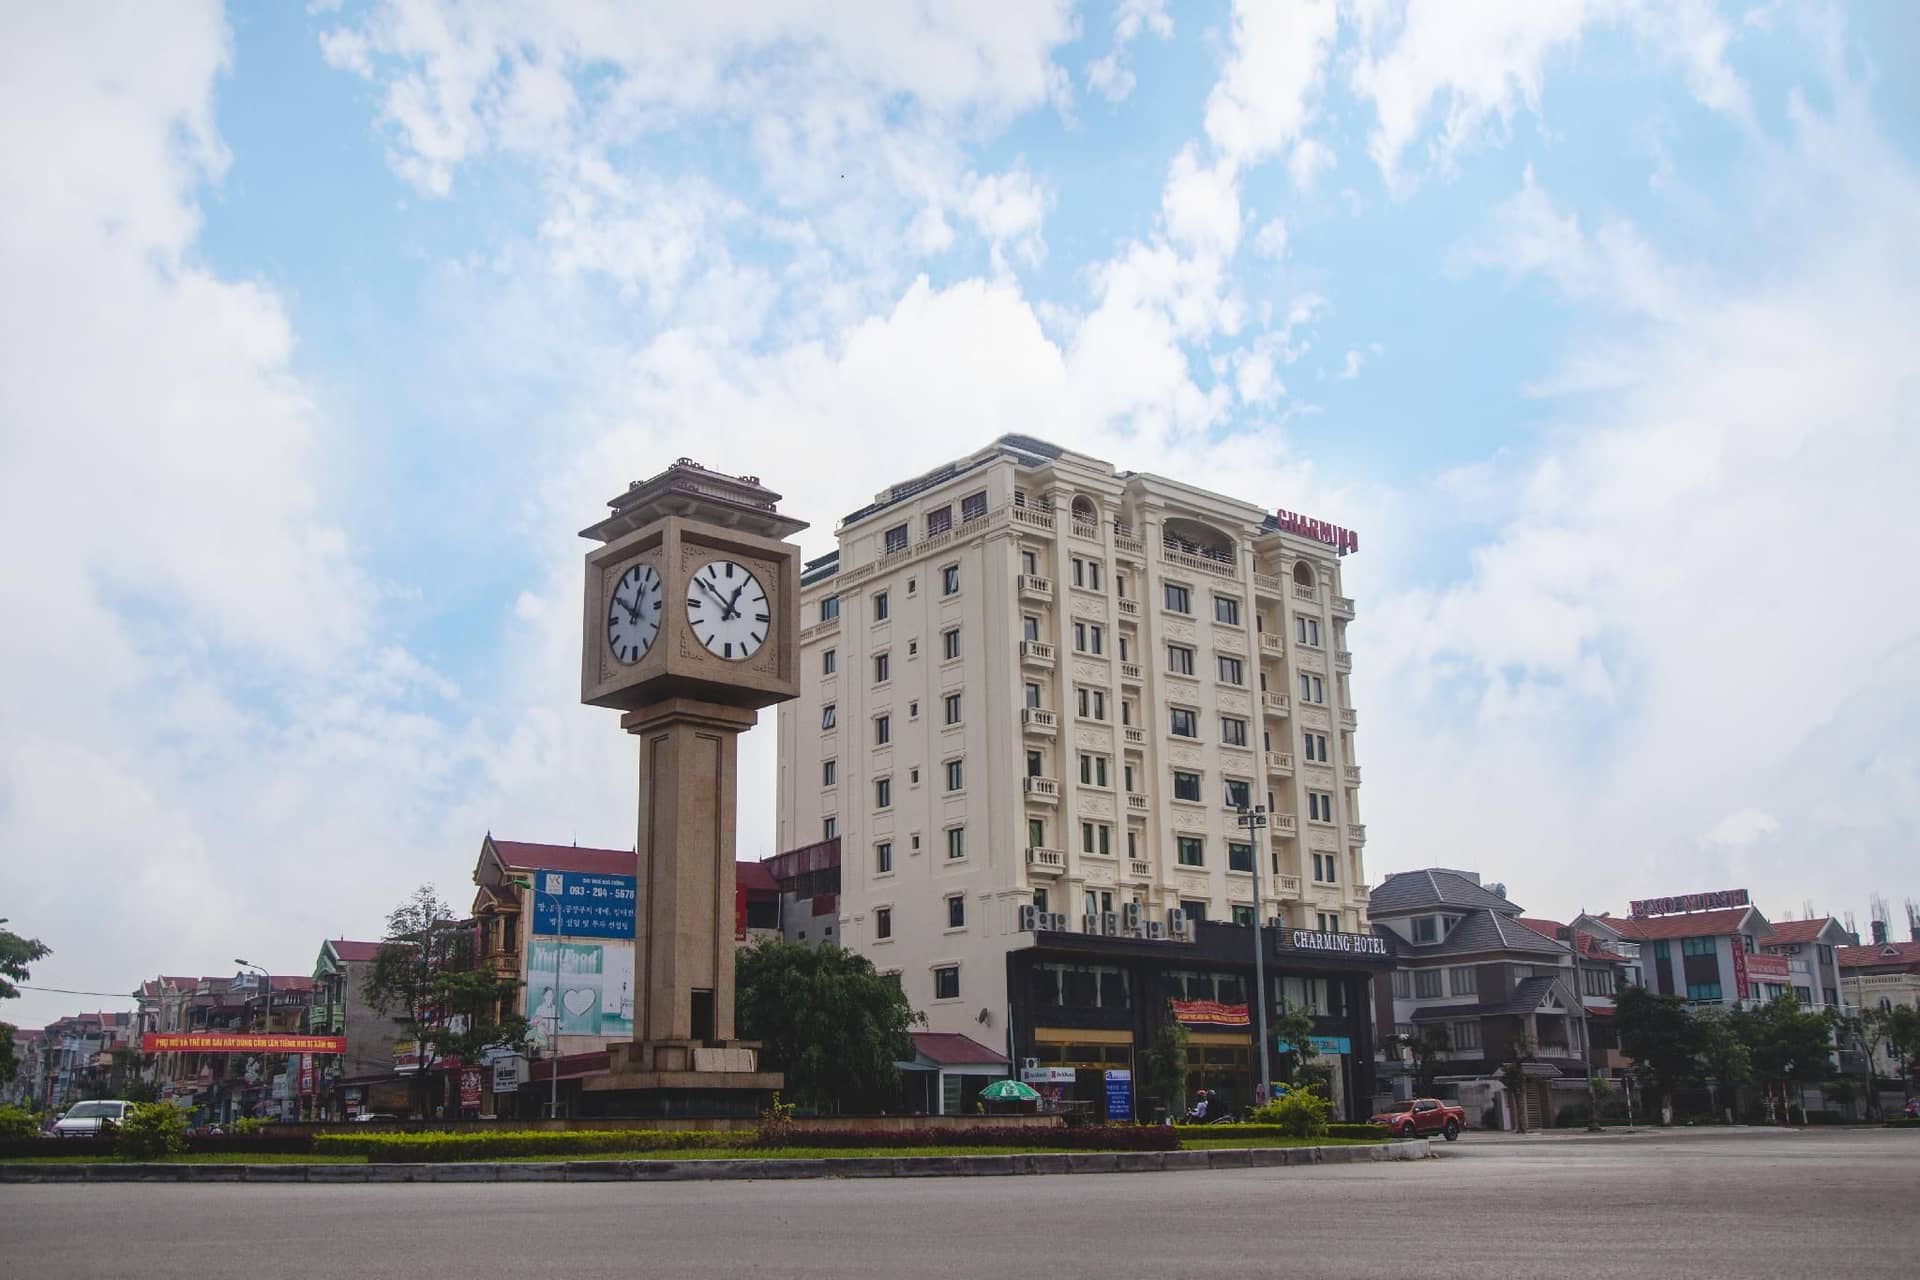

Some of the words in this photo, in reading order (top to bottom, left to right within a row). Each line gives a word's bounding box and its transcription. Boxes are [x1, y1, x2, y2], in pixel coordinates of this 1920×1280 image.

[569, 886, 585, 896] 093
[1293, 931, 1350, 952] CHARMING
[1354, 936, 1387, 954] HOTEL
